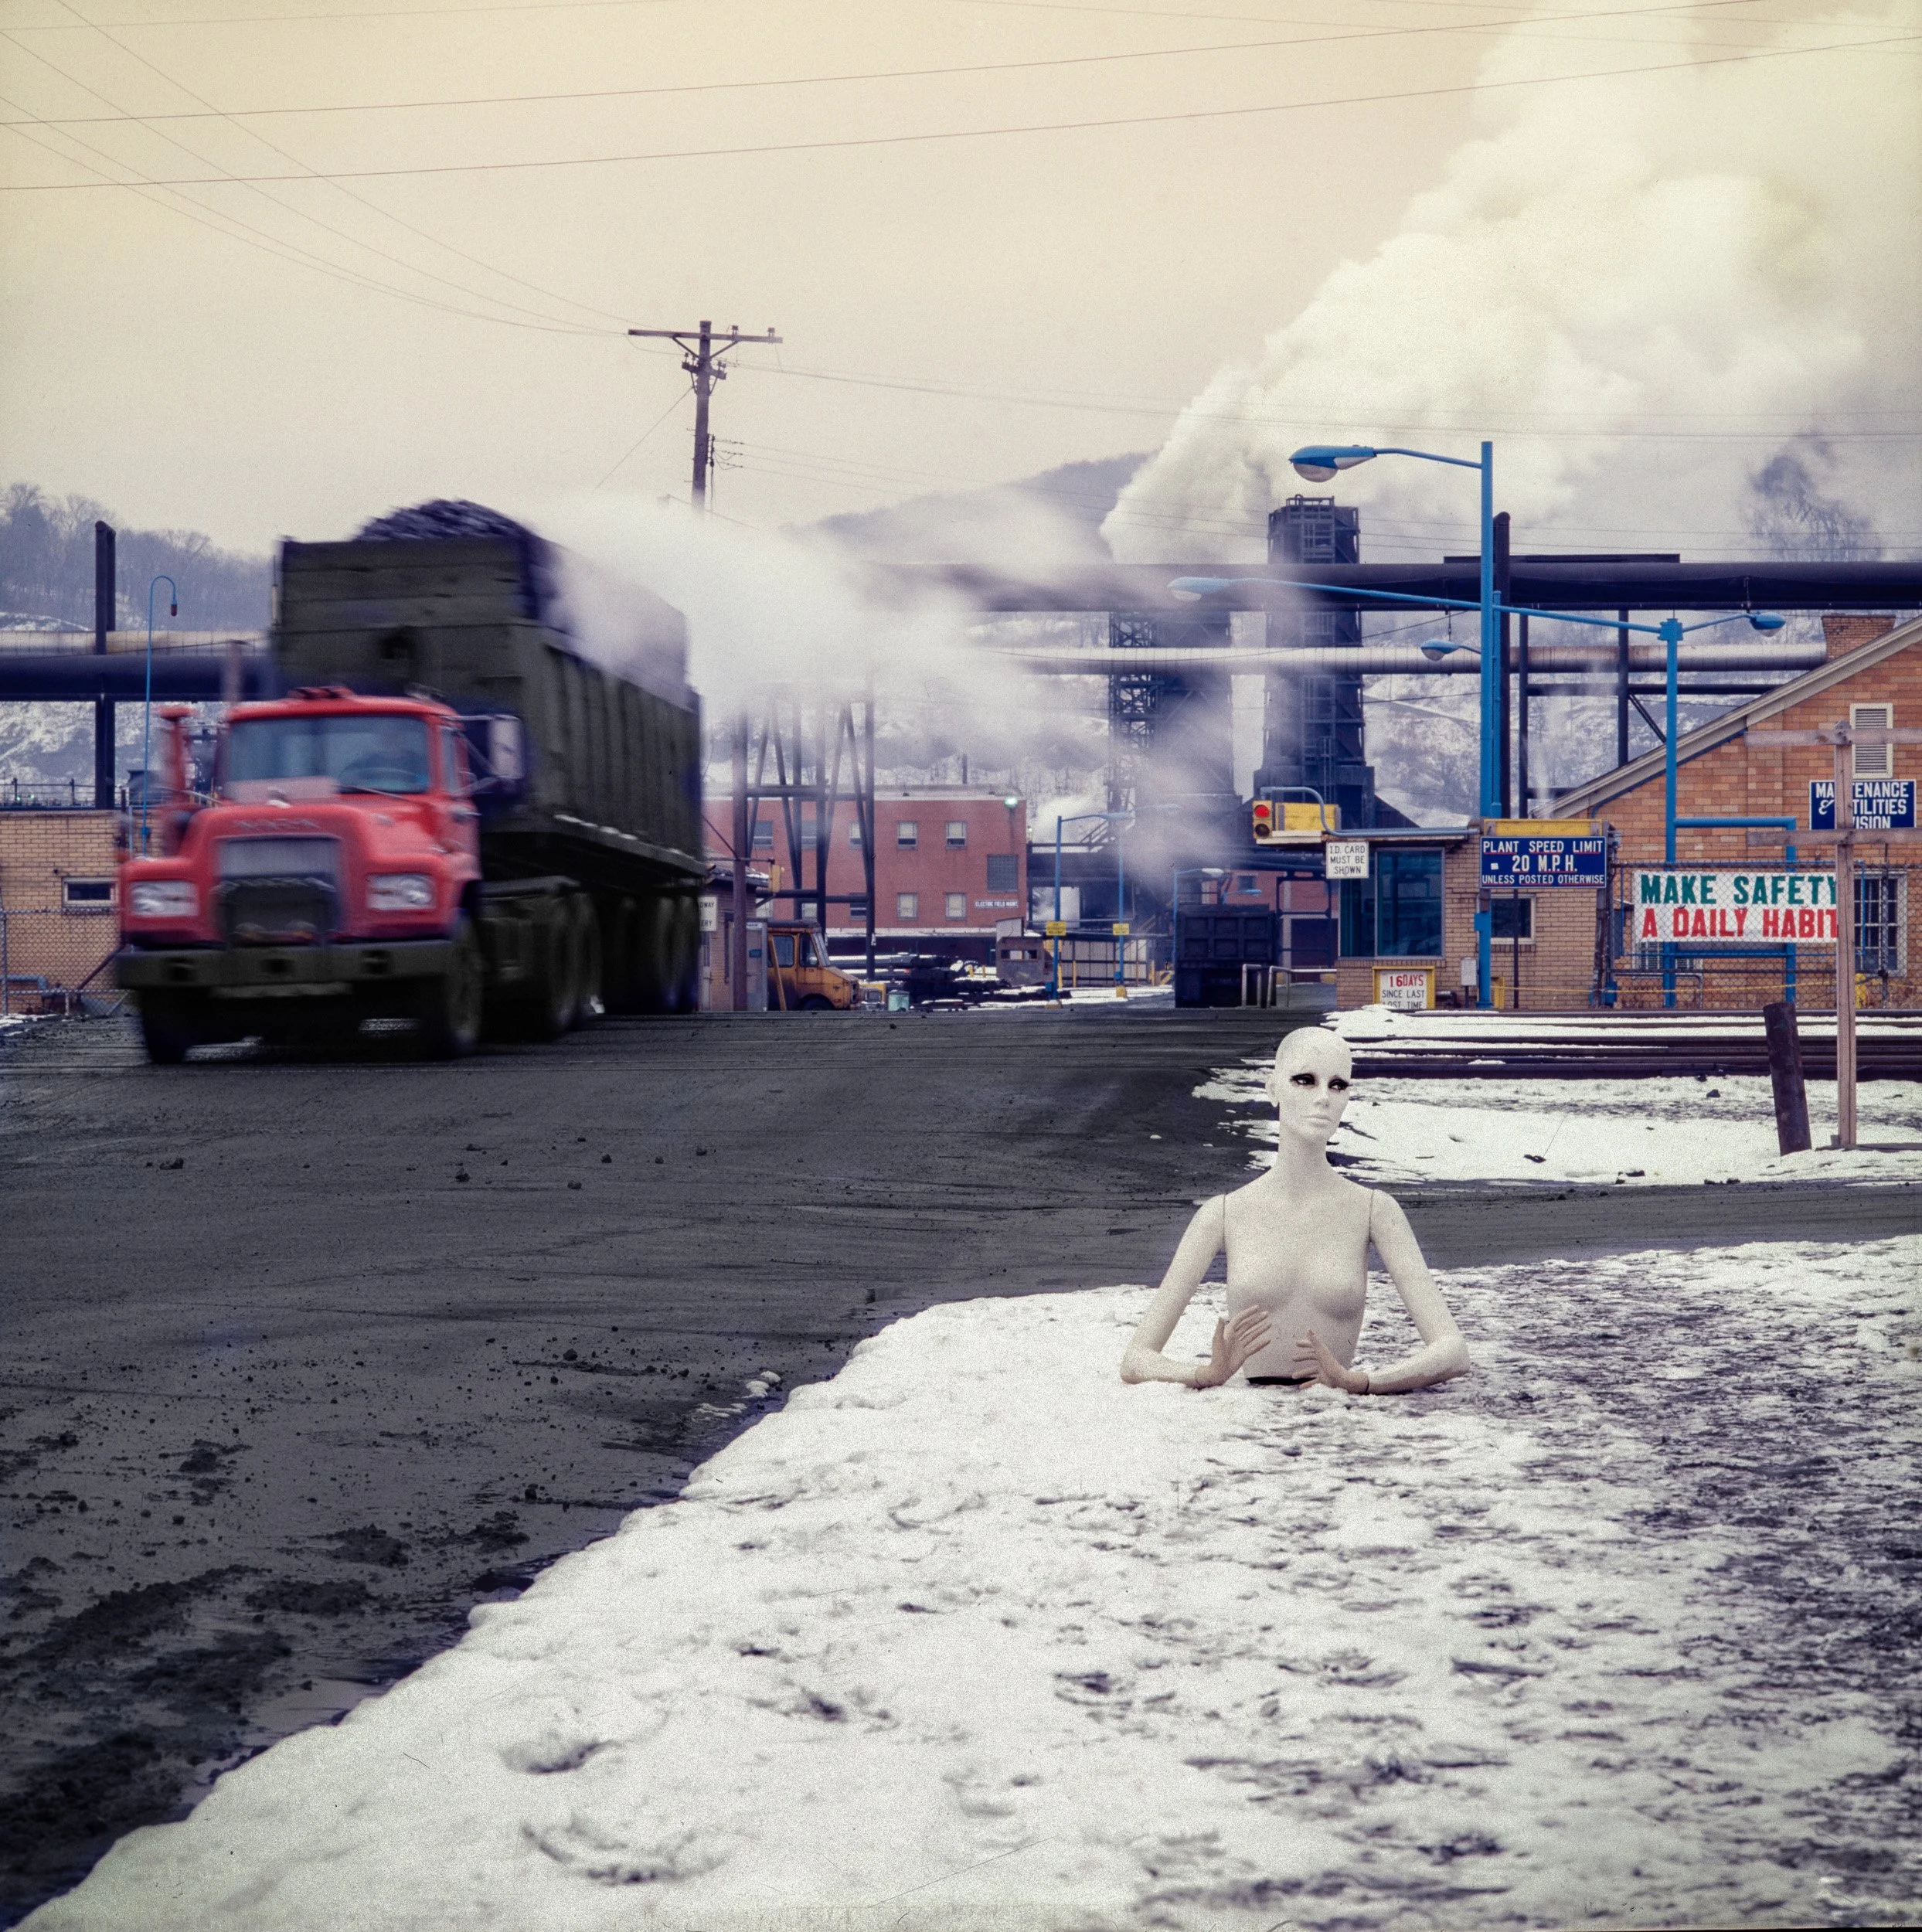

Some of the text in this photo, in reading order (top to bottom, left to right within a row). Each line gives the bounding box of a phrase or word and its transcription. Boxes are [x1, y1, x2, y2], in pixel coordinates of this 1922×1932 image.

[1816, 782, 1909, 798] MAENANCE
[1818, 798, 1907, 815] & TILITIES
[1852, 815, 1890, 829] ISION
[1345, 845, 1365, 854] CARD
[1483, 840, 1603, 852] PLANT SPEED LIMIT
[1330, 855, 1365, 864] MUST BE
[1512, 855, 1577, 872] 20 M.P.H.
[1334, 866, 1361, 874] SHOWN
[1482, 875, 1604, 884] UNLESS POSTED OTHERWISE
[1641, 875, 1836, 905] MAKE SAFETY
[1642, 907, 1839, 939] A DAILY HABIT
